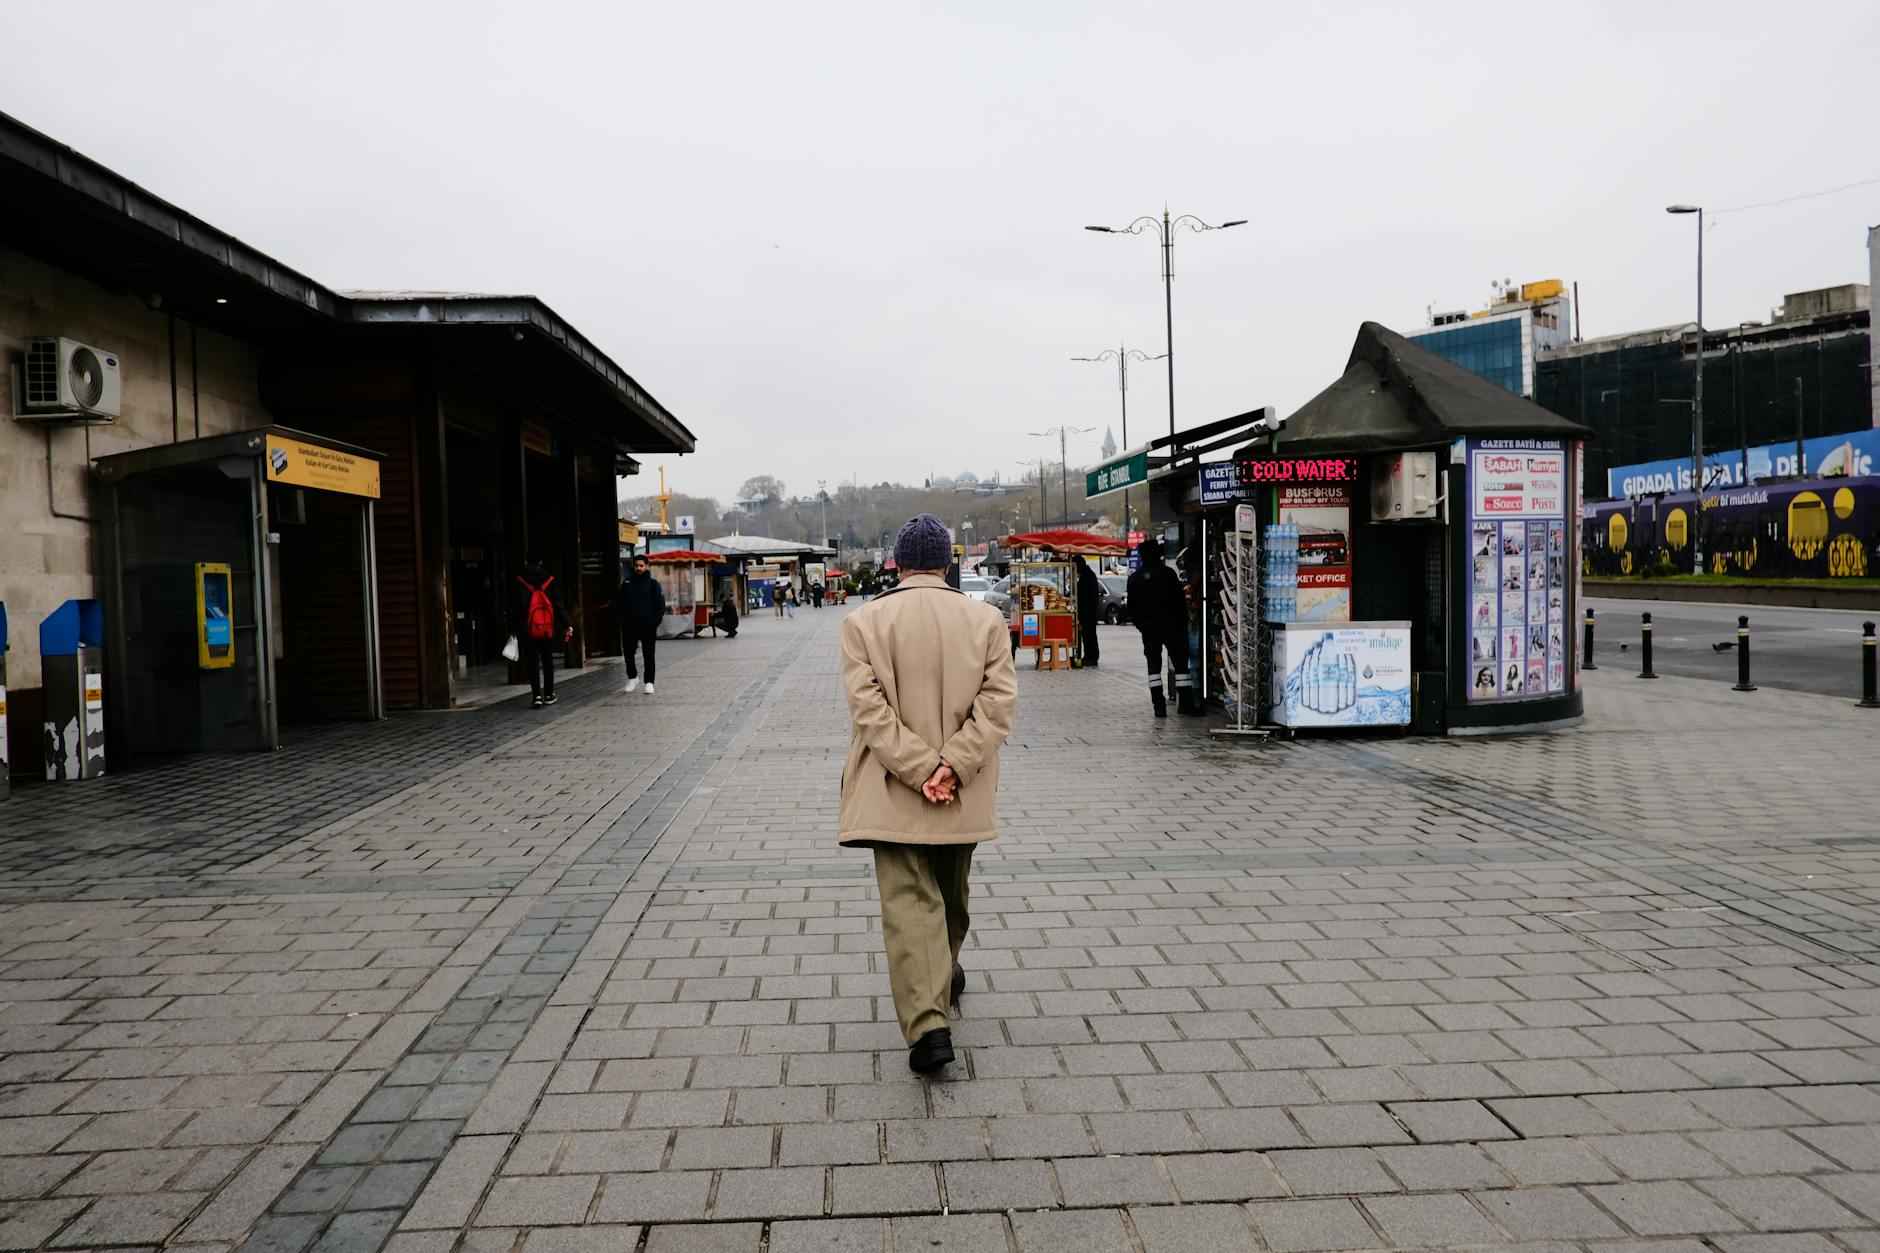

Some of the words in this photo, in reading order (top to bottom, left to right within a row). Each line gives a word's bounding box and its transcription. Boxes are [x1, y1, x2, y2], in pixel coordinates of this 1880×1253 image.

[1480, 439, 1514, 449] GAZETE
[1253, 462, 1293, 479] COLD
[1295, 460, 1346, 480] WATER
[1623, 471, 1675, 497] GIDADA
[1730, 490, 1768, 506] mutluluk
[1297, 574, 1314, 583] KET
[1315, 574, 1346, 583] OFFICE
